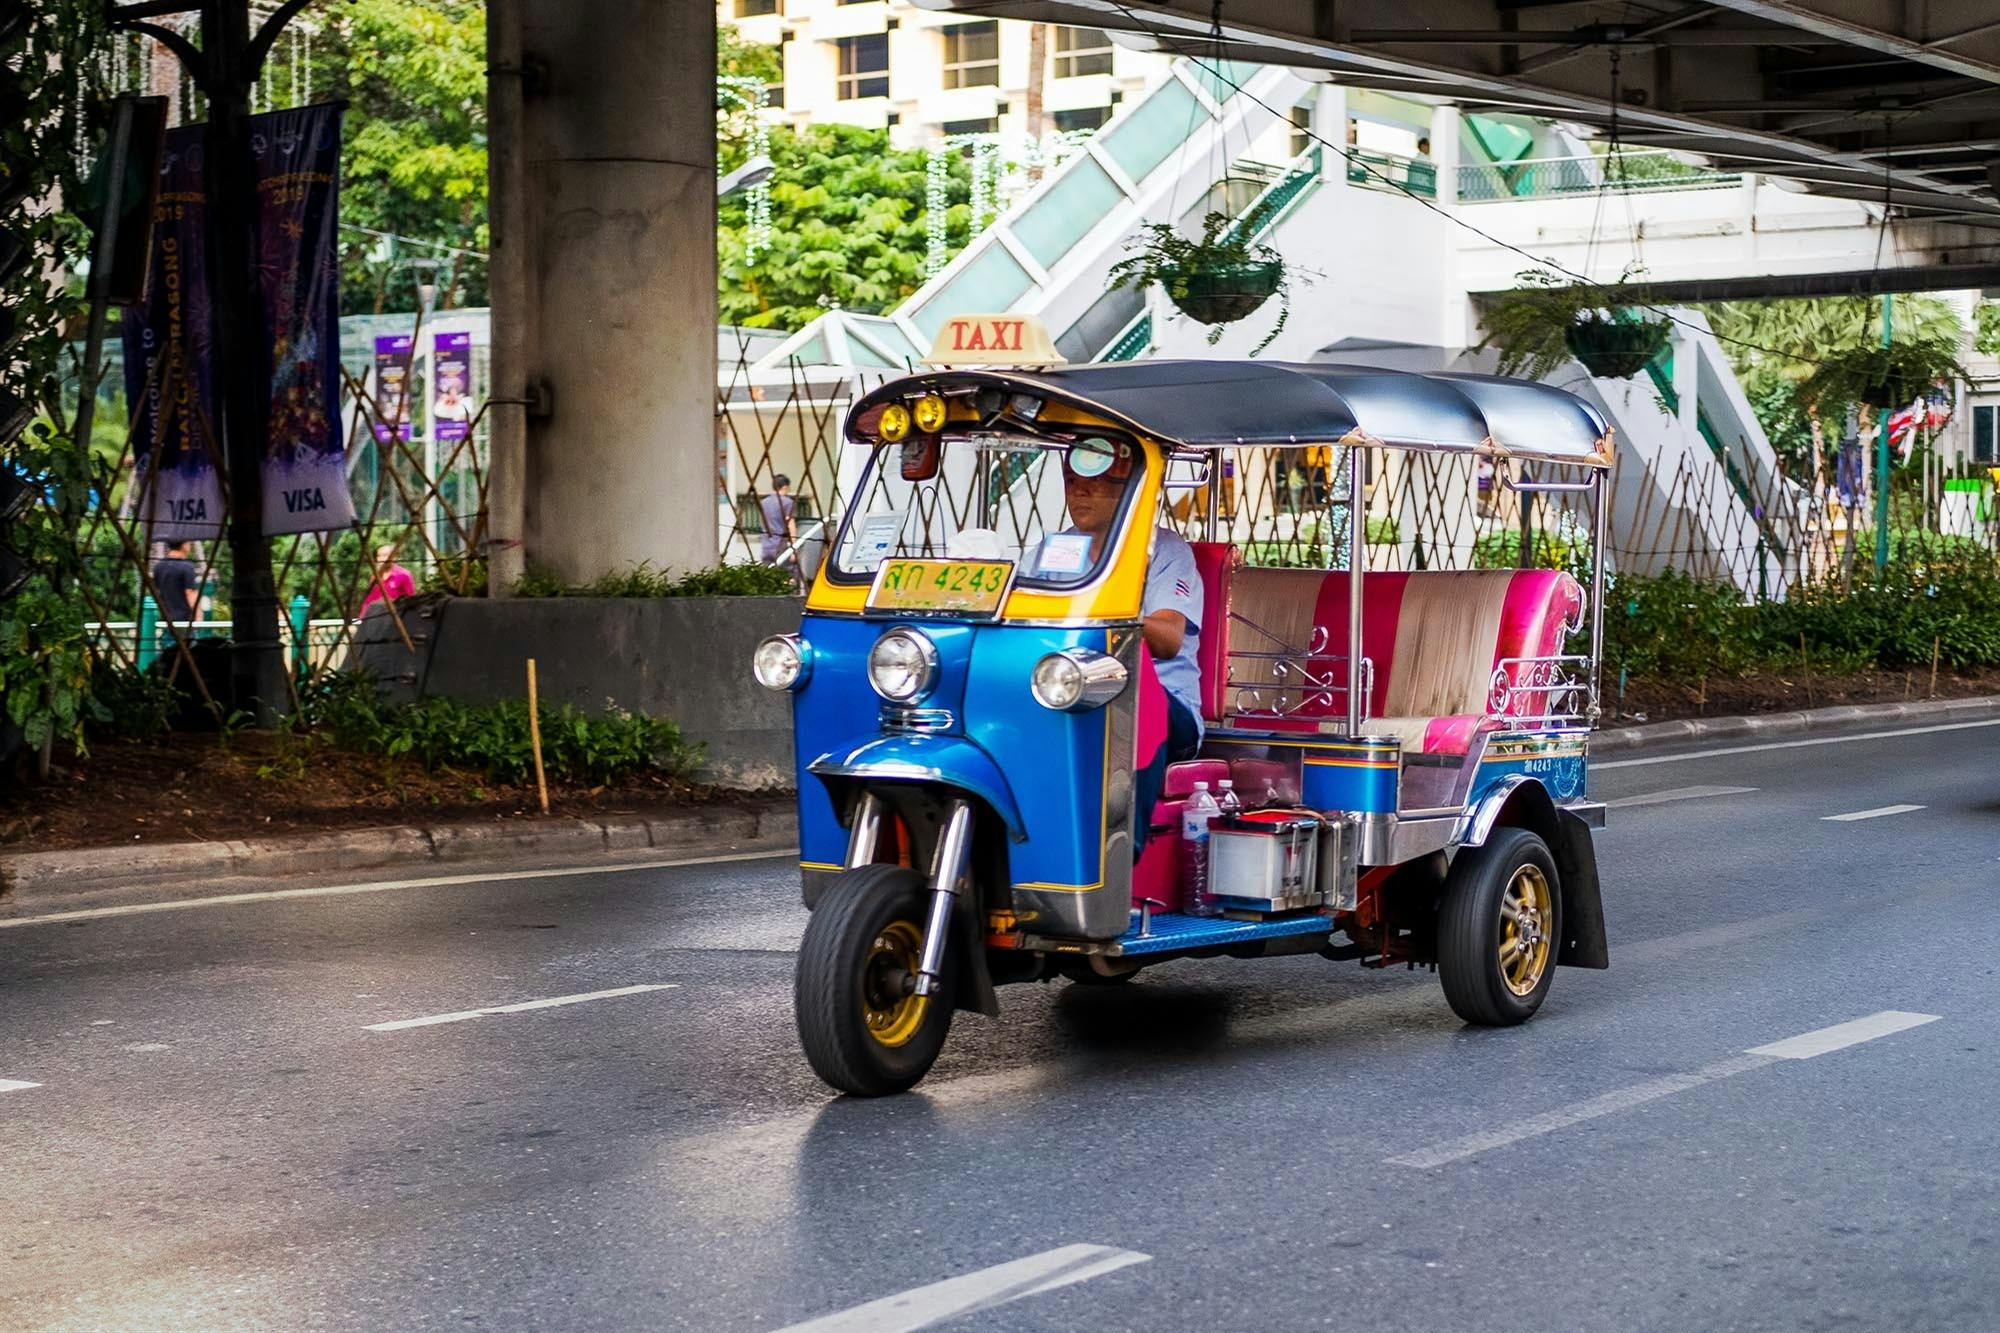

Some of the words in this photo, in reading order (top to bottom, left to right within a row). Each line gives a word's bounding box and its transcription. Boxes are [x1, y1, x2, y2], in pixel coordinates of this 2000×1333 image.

[949, 321, 1026, 350] TAXI
[165, 498, 207, 521] VISA
[282, 487, 326, 513] VISA
[934, 565, 1004, 593] 4243
